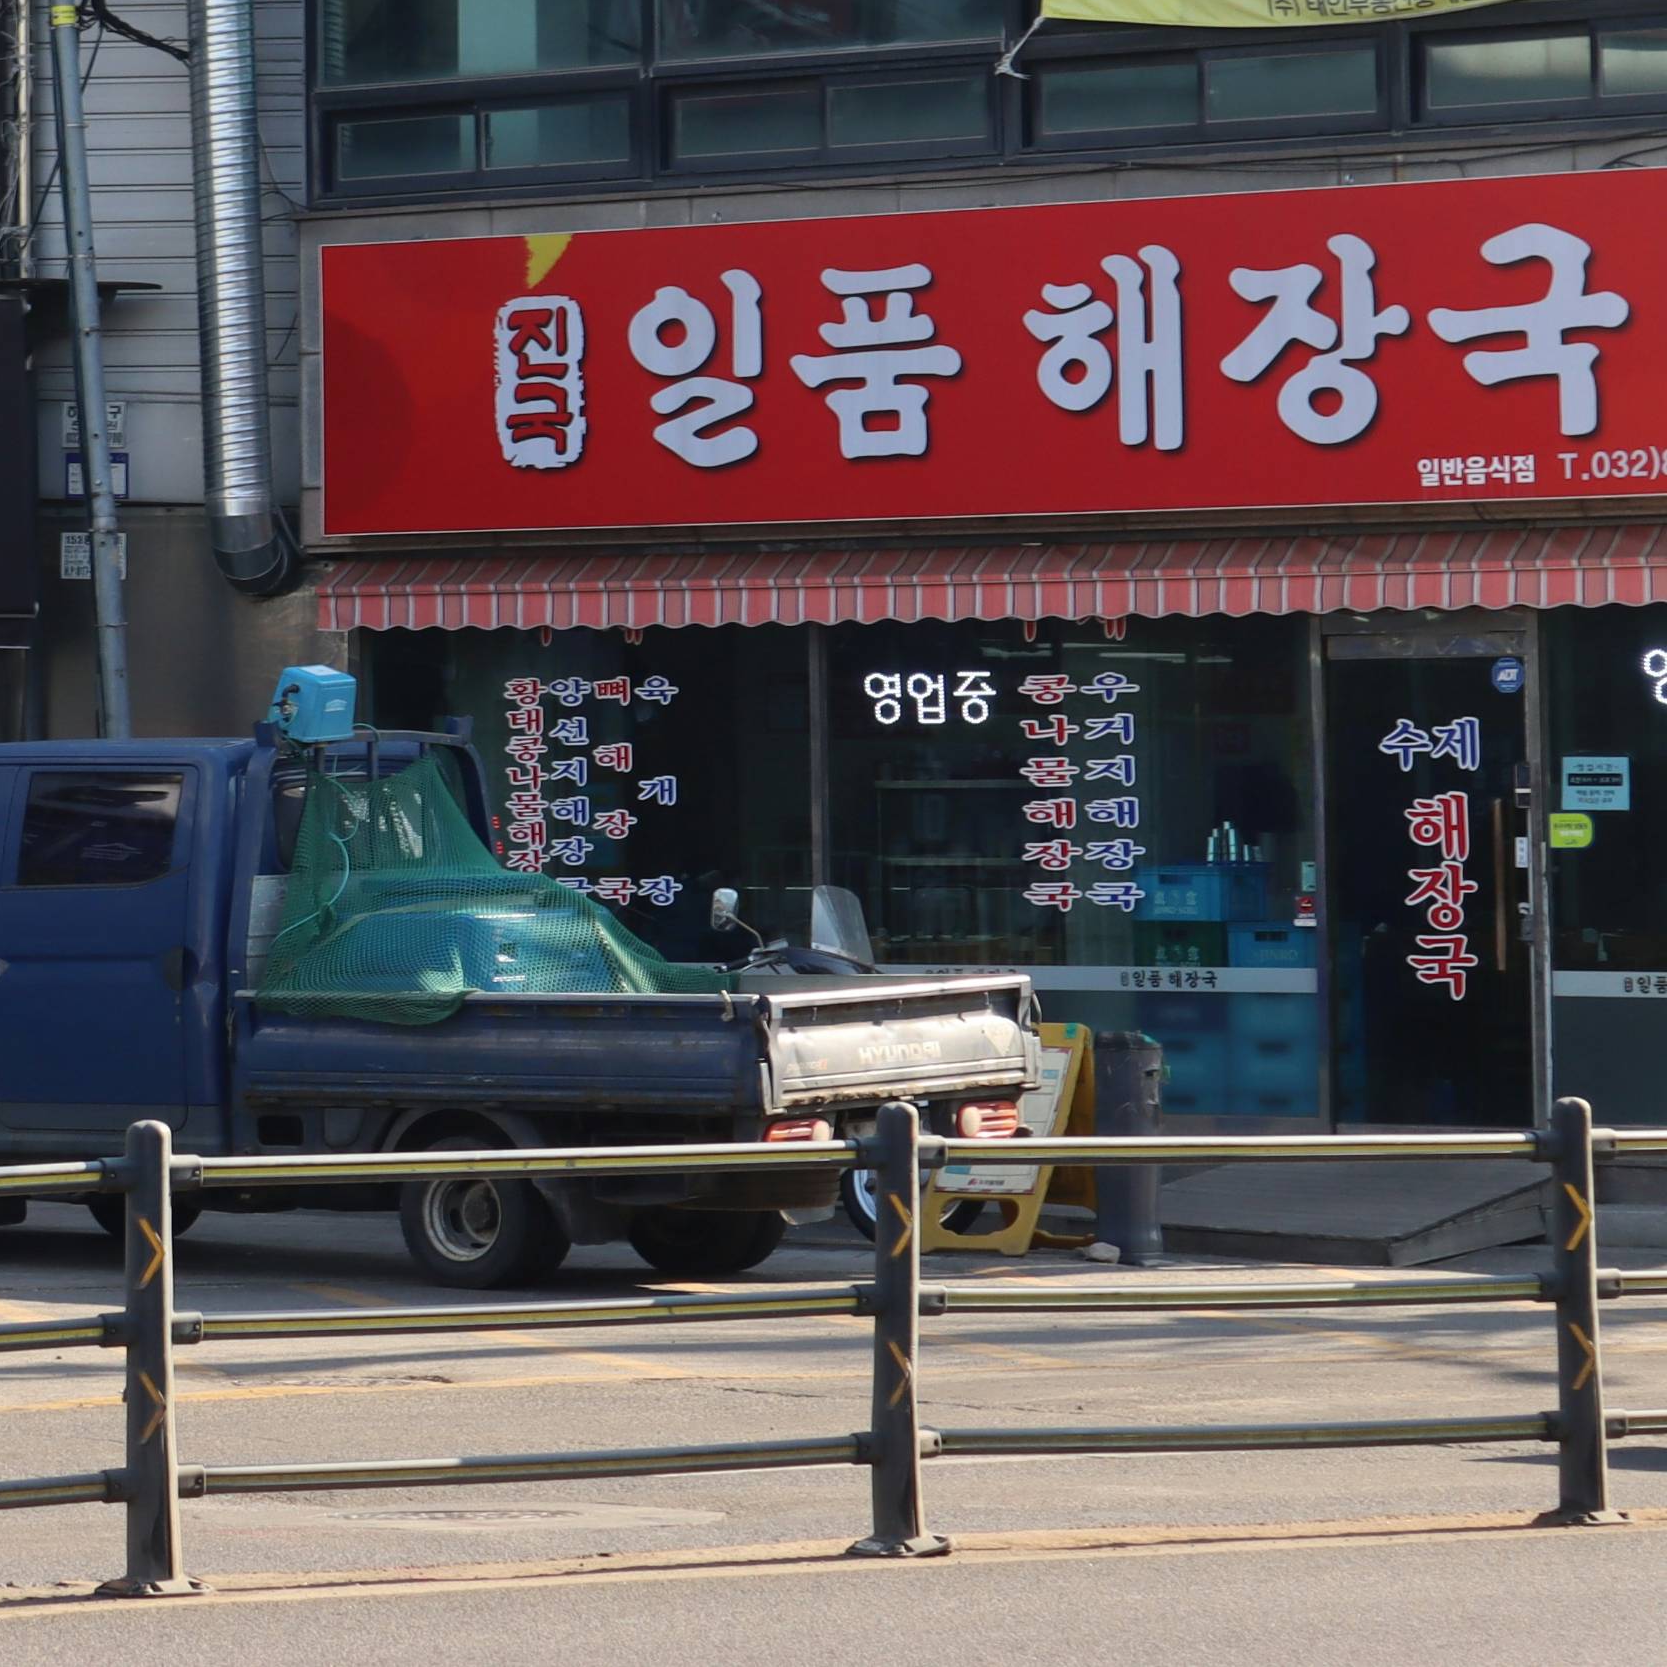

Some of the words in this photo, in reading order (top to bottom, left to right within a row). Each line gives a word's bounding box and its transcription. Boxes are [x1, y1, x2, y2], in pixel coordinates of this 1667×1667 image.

[506, 305, 574, 455] 진국
[627, 261, 963, 468] 일품
[1021, 222, 1630, 452] 해장국
[1416, 454, 1536, 487] 일반음식점
[863, 670, 998, 725] 영업중
[1378, 715, 1481, 772] 수제
[1496, 667, 1519, 682] ADT
[591, 675, 639, 907] 뼈해장국
[634, 674, 684, 907] 육개장
[1016, 673, 1083, 913] 콩나물해장국
[1079, 671, 1147, 913] 우거지해장국
[1403, 790, 1479, 1002] 해장국
